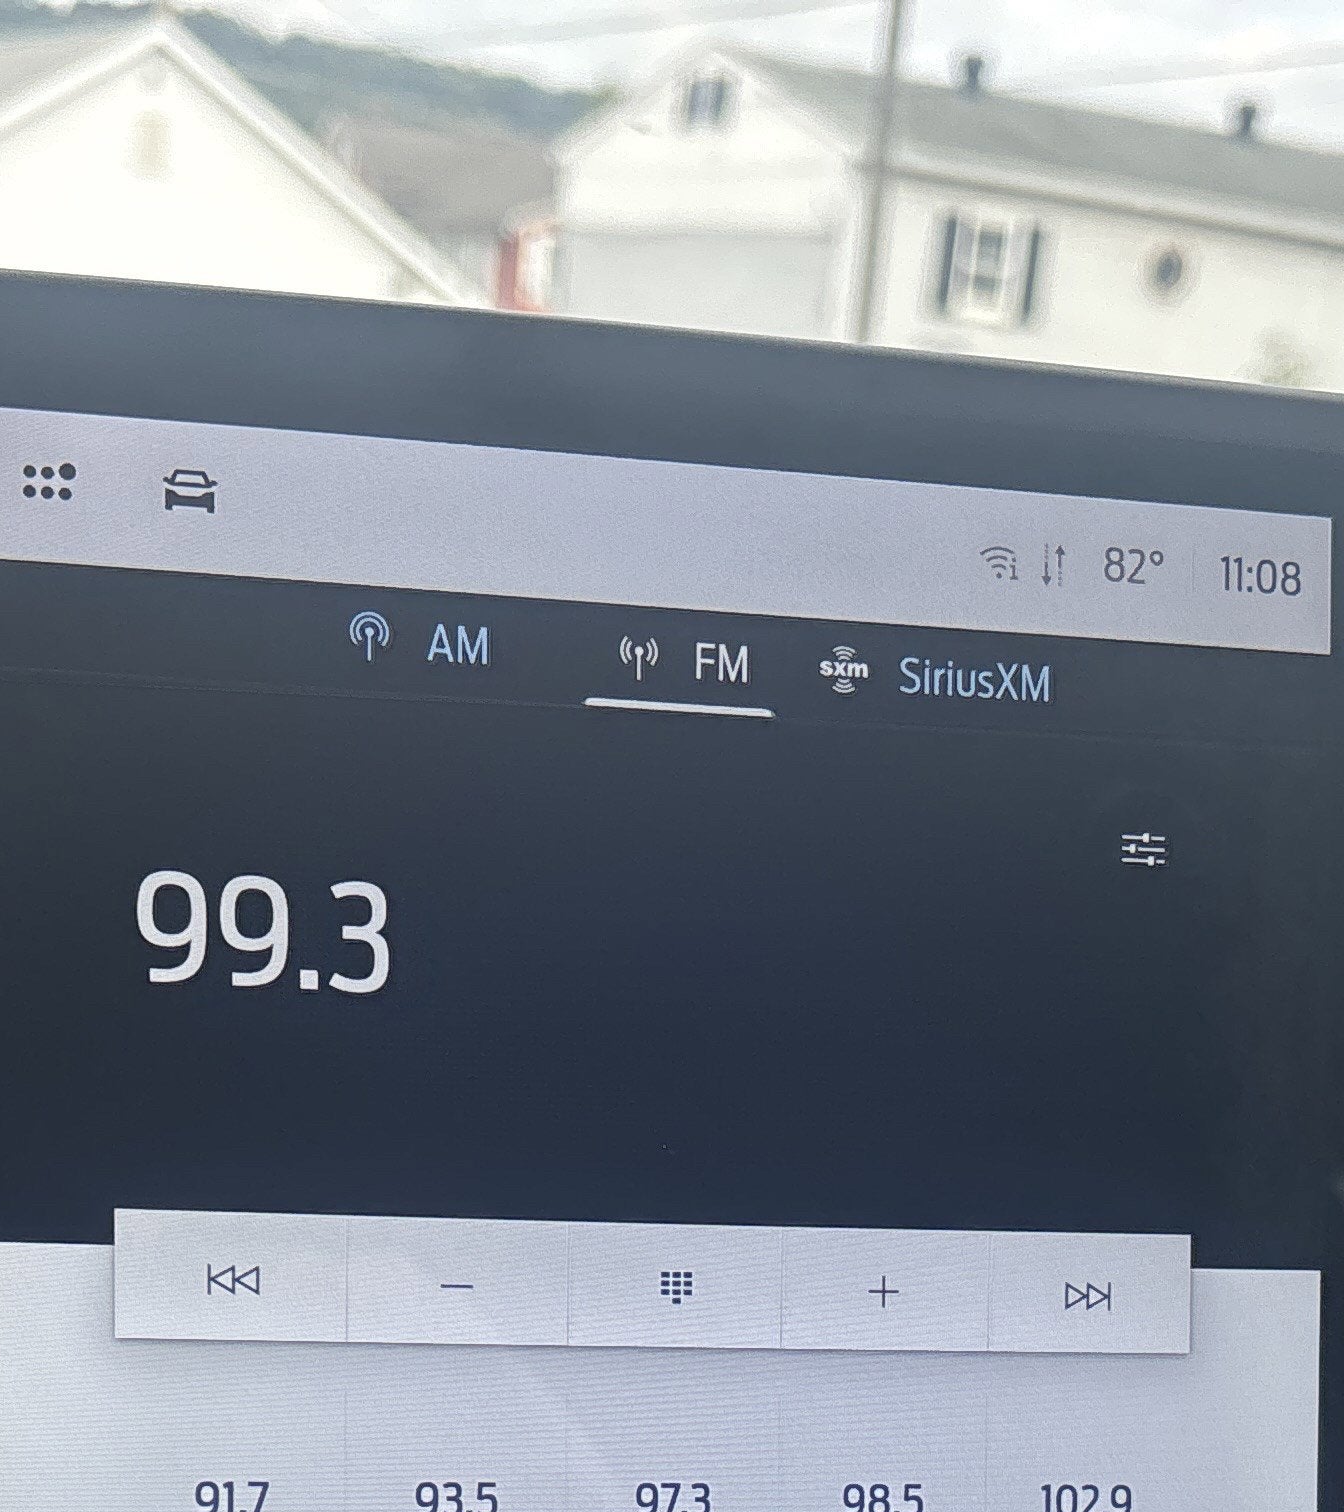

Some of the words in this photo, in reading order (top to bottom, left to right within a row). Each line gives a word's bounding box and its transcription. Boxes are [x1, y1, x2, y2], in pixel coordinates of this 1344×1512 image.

[1220, 555, 1302, 597] 11:08
[427, 623, 490, 666] AM
[694, 642, 749, 684] FM
[899, 657, 1050, 703] SiriusXM
[136, 870, 390, 994] 99.3
